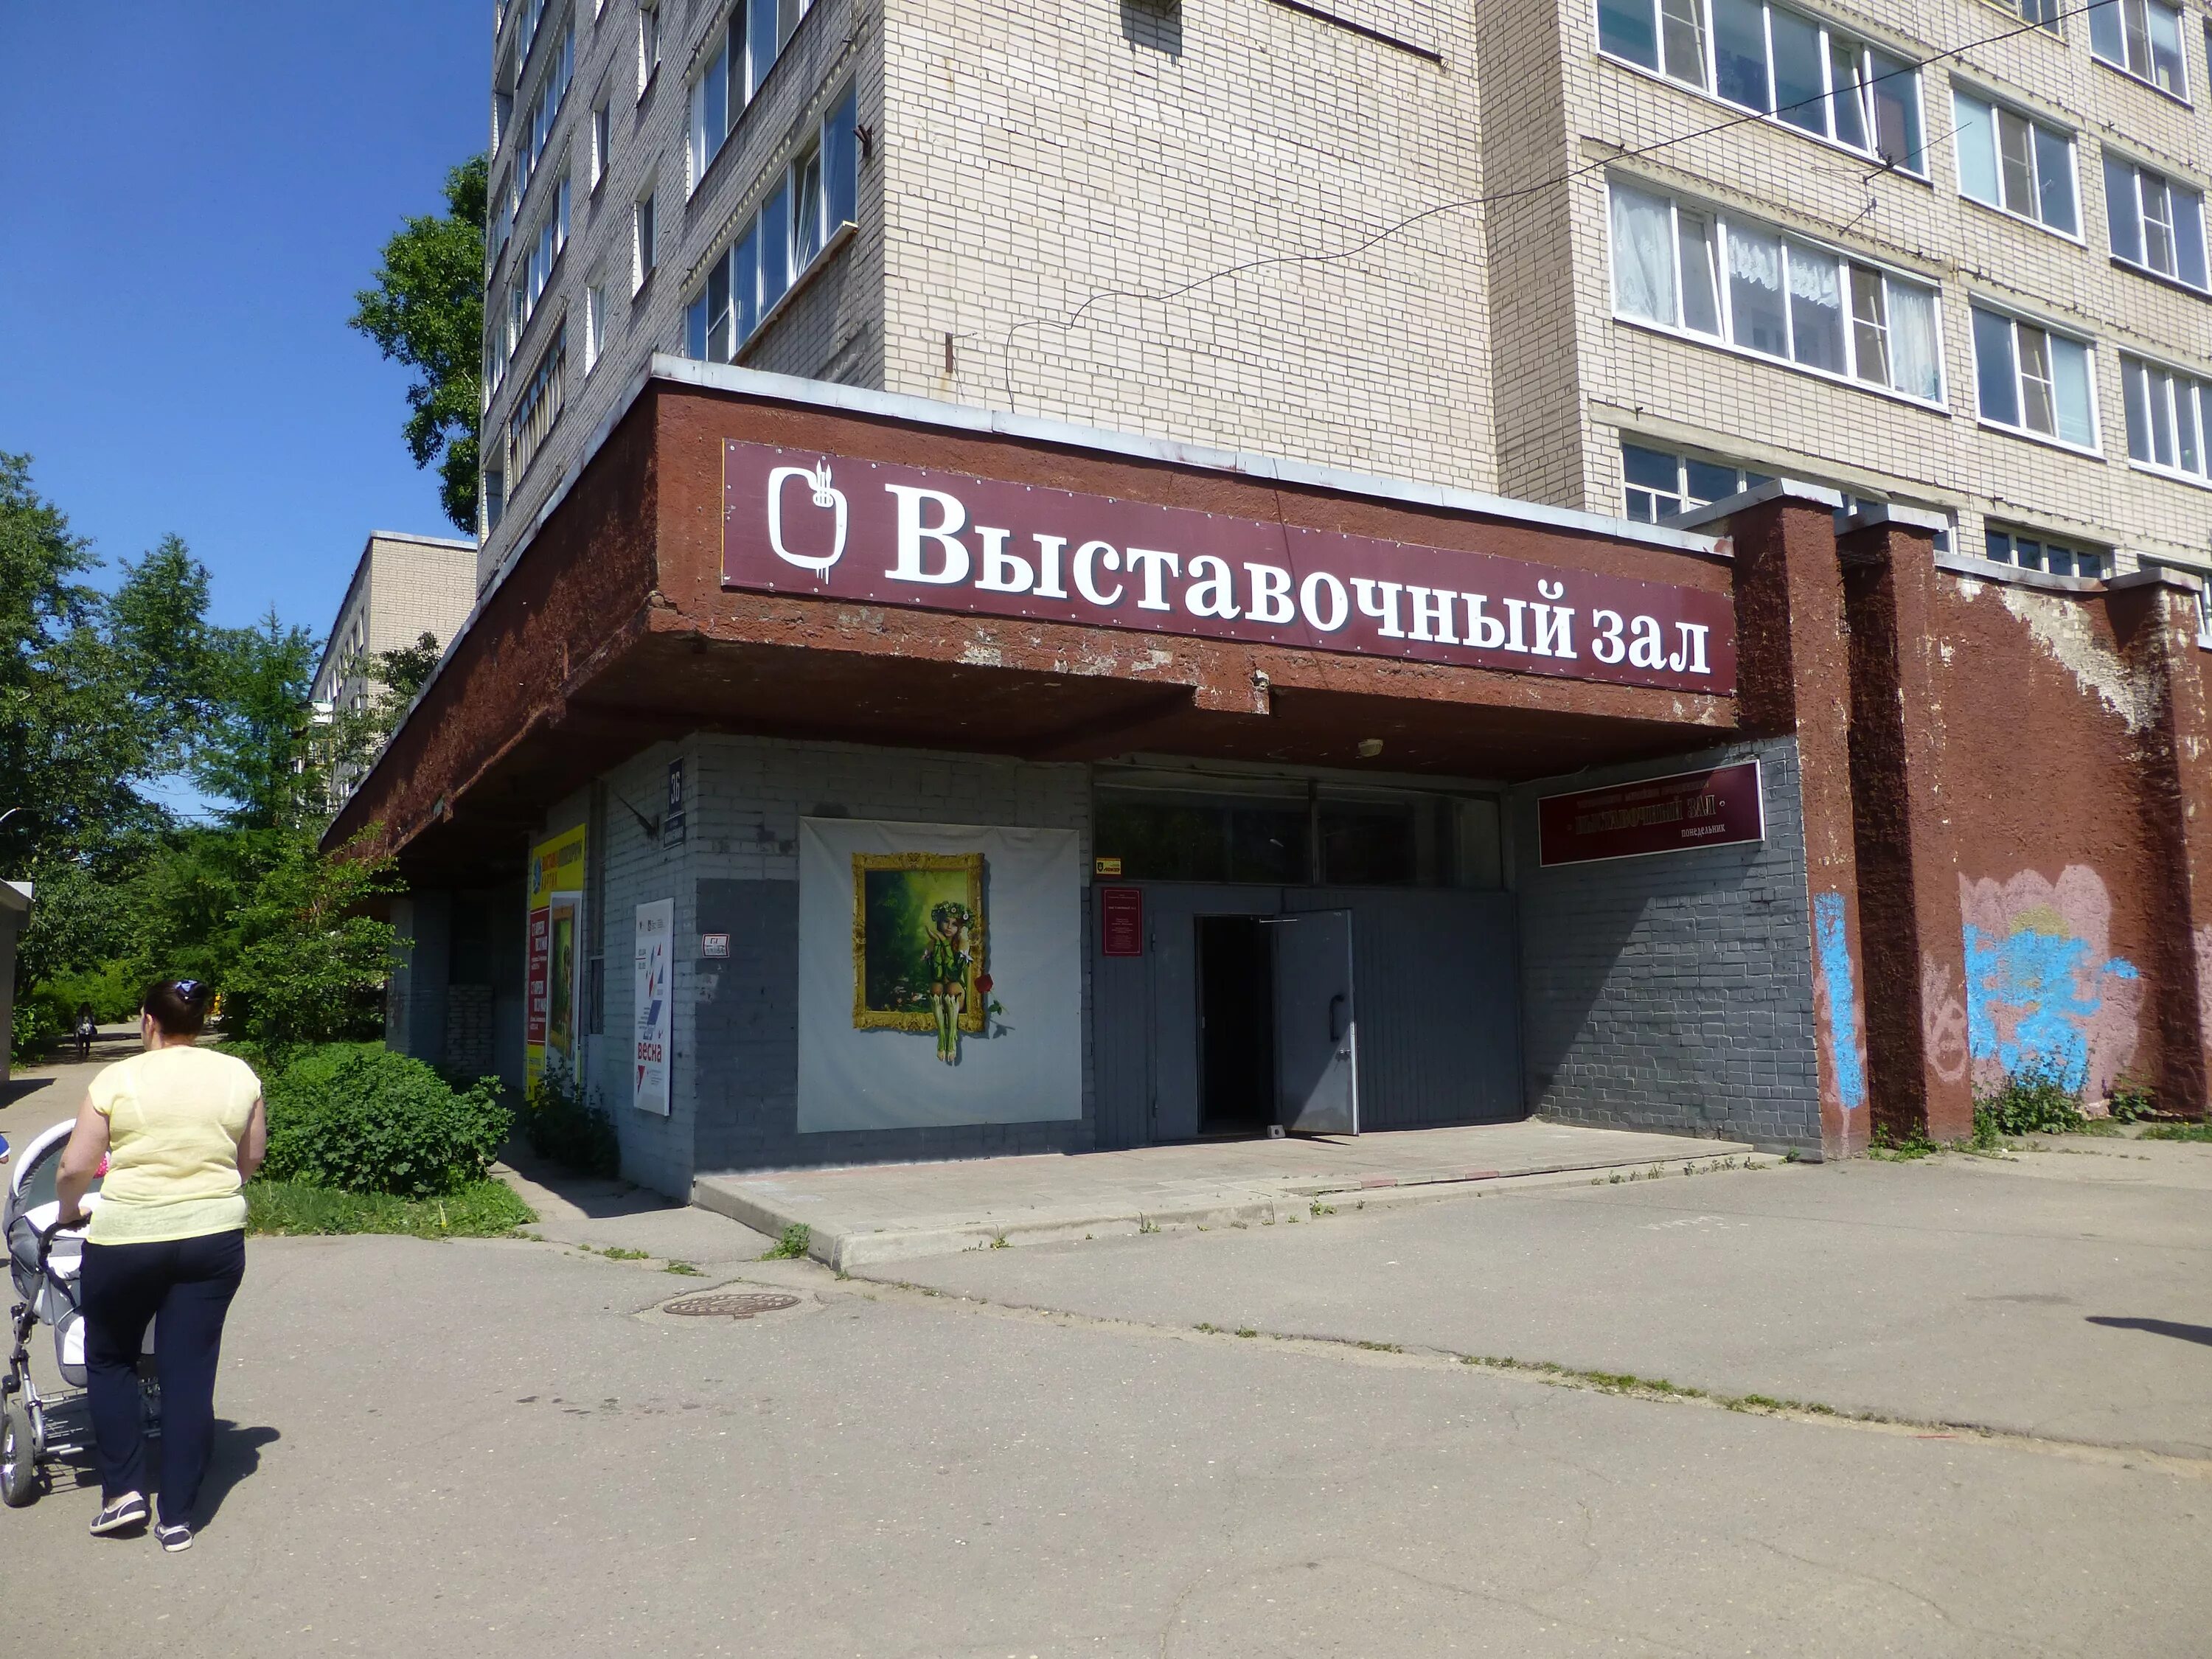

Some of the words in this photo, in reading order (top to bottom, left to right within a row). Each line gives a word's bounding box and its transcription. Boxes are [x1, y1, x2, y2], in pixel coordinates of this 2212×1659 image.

[885, 483, 1577, 660] Выставочный
[1591, 608, 1711, 674] зал
[671, 771, 681, 804] 36
[1687, 794, 1717, 818] ЗАЛ
[1681, 824, 1725, 838] понедельник
[638, 1042, 662, 1063] весна
